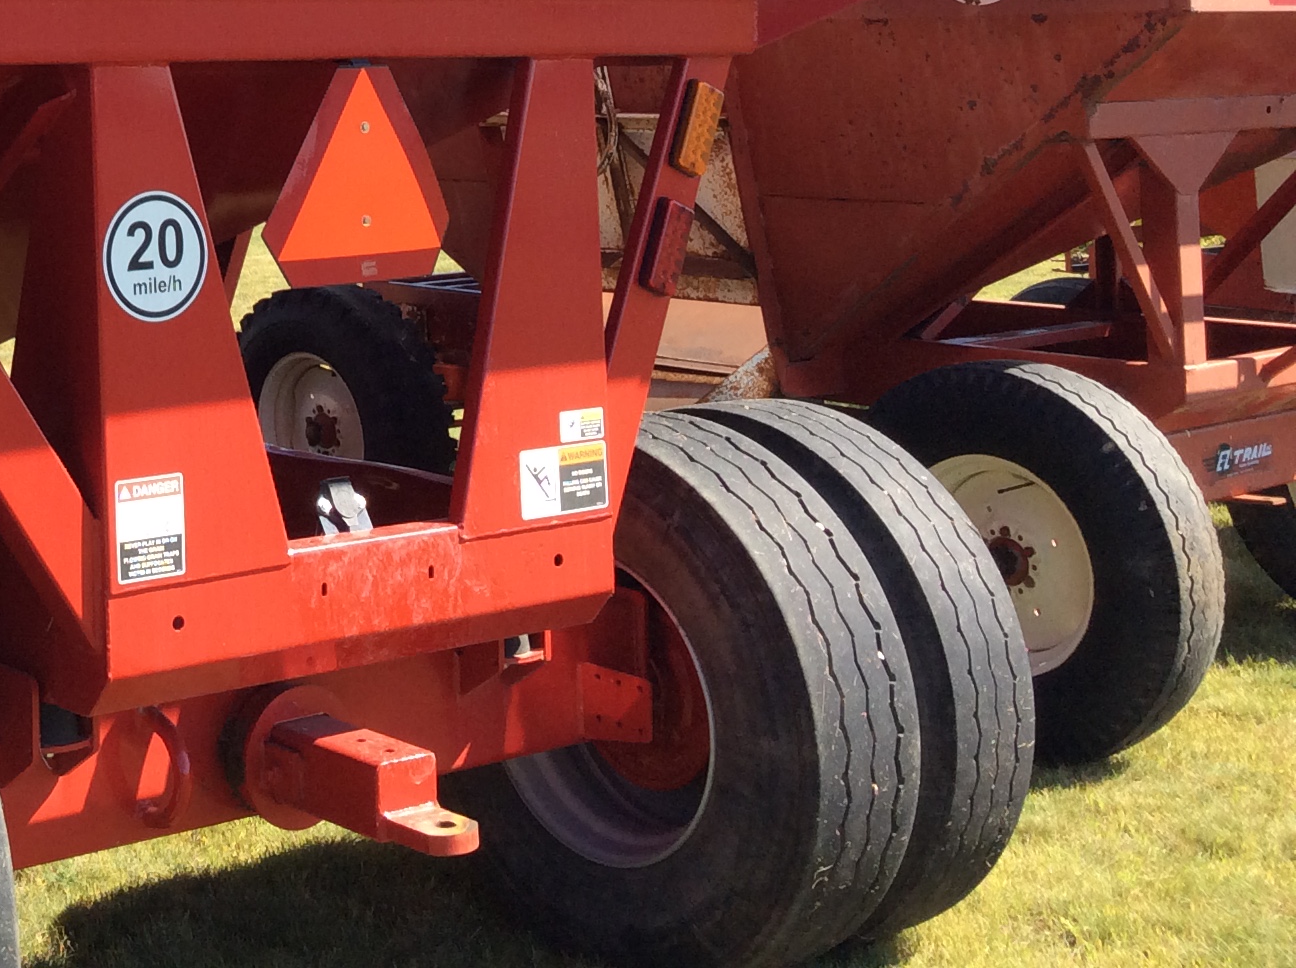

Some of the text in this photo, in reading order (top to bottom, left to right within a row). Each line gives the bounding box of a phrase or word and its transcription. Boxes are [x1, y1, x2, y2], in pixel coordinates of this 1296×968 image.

[126, 218, 184, 272] 20
[133, 275, 182, 296] mile/h
[568, 448, 603, 461] WARNING
[132, 480, 179, 498] DANGER
